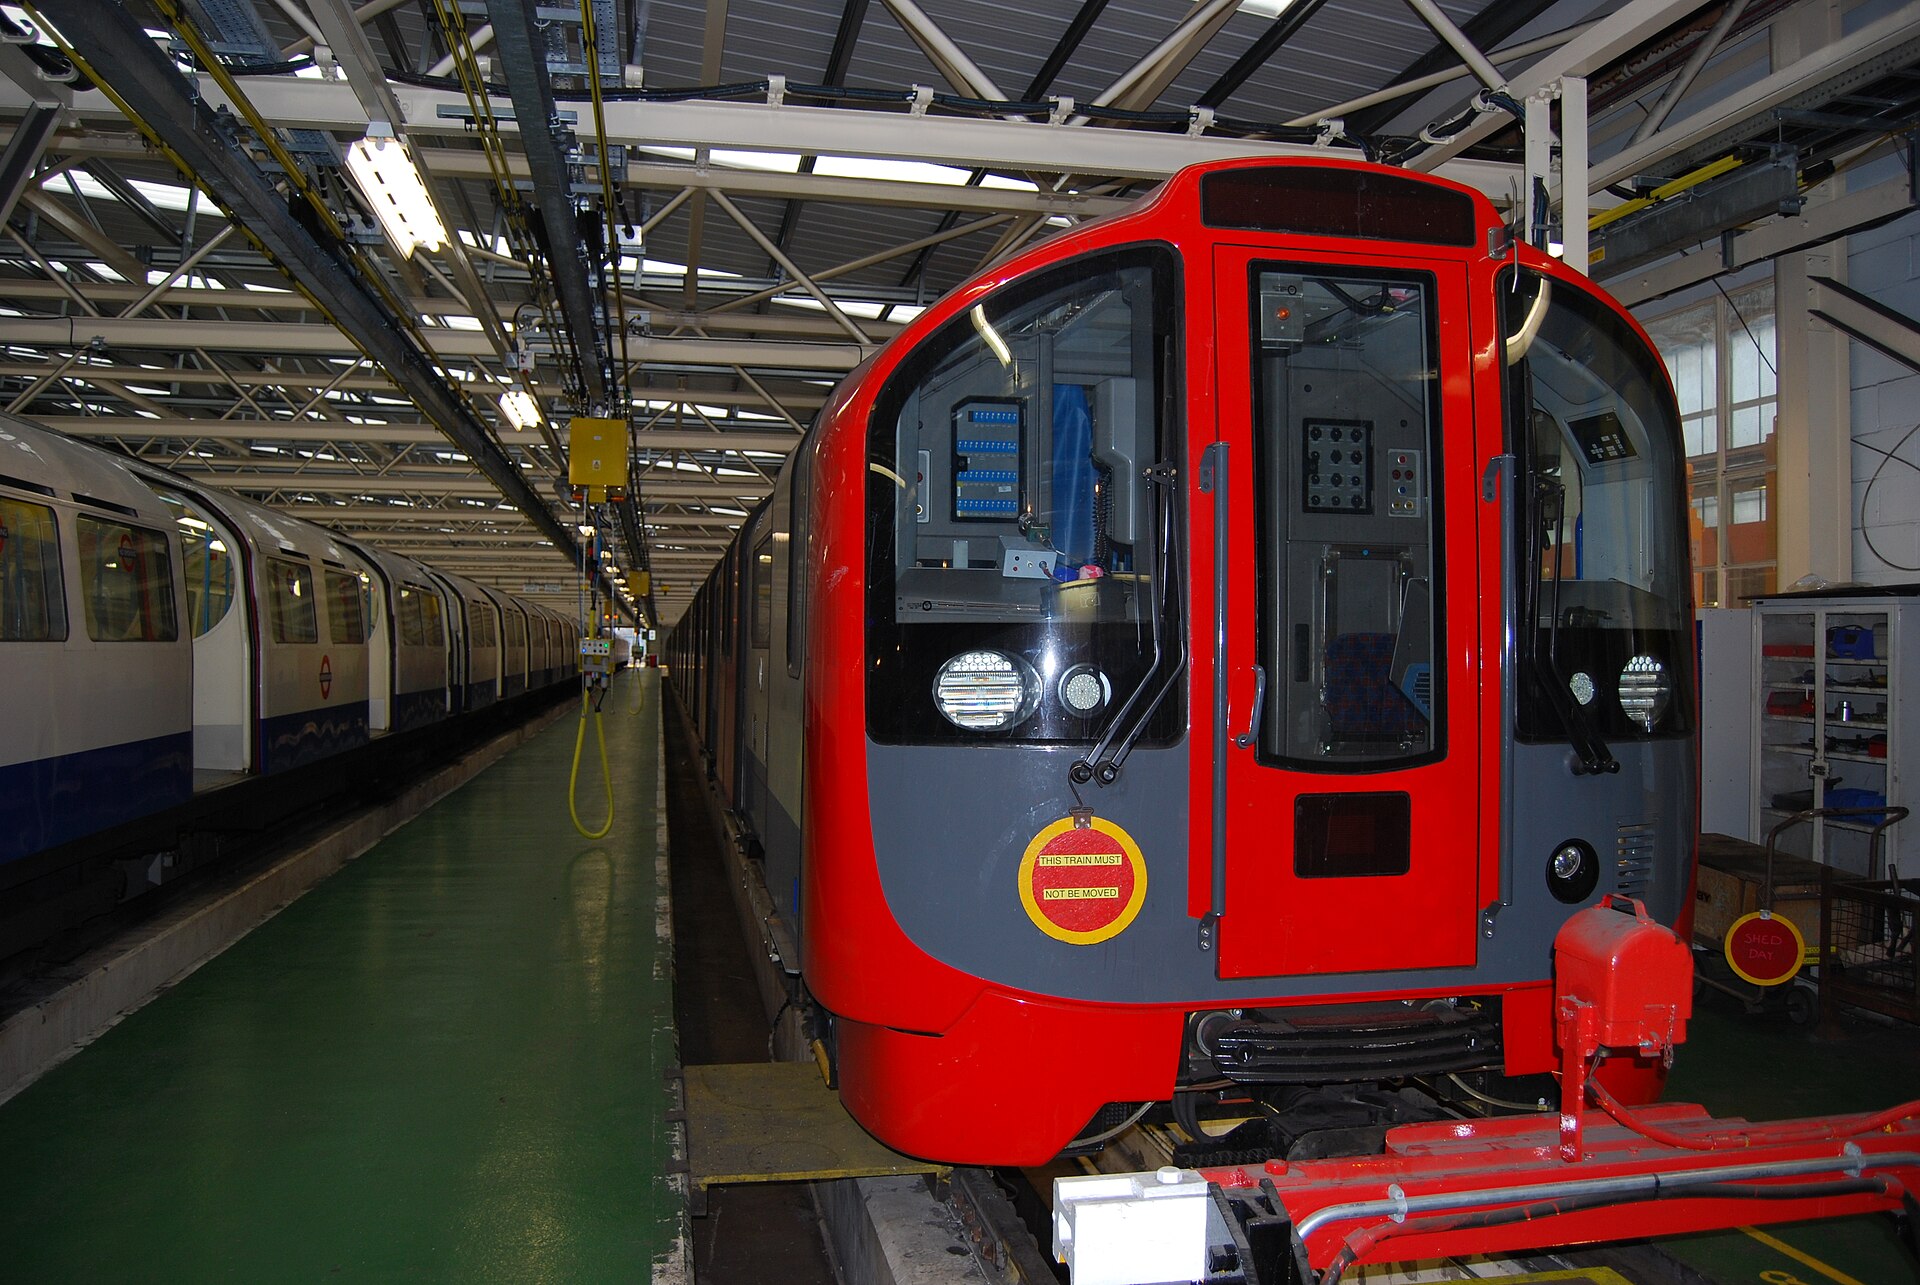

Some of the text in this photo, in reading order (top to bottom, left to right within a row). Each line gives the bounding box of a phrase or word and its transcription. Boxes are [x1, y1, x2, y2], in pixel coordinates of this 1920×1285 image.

[1040, 855, 1121, 865] THIS TRAIN MUST
[1045, 889, 1117, 898] NOT BE MOVED
[1743, 933, 1783, 945] SHED
